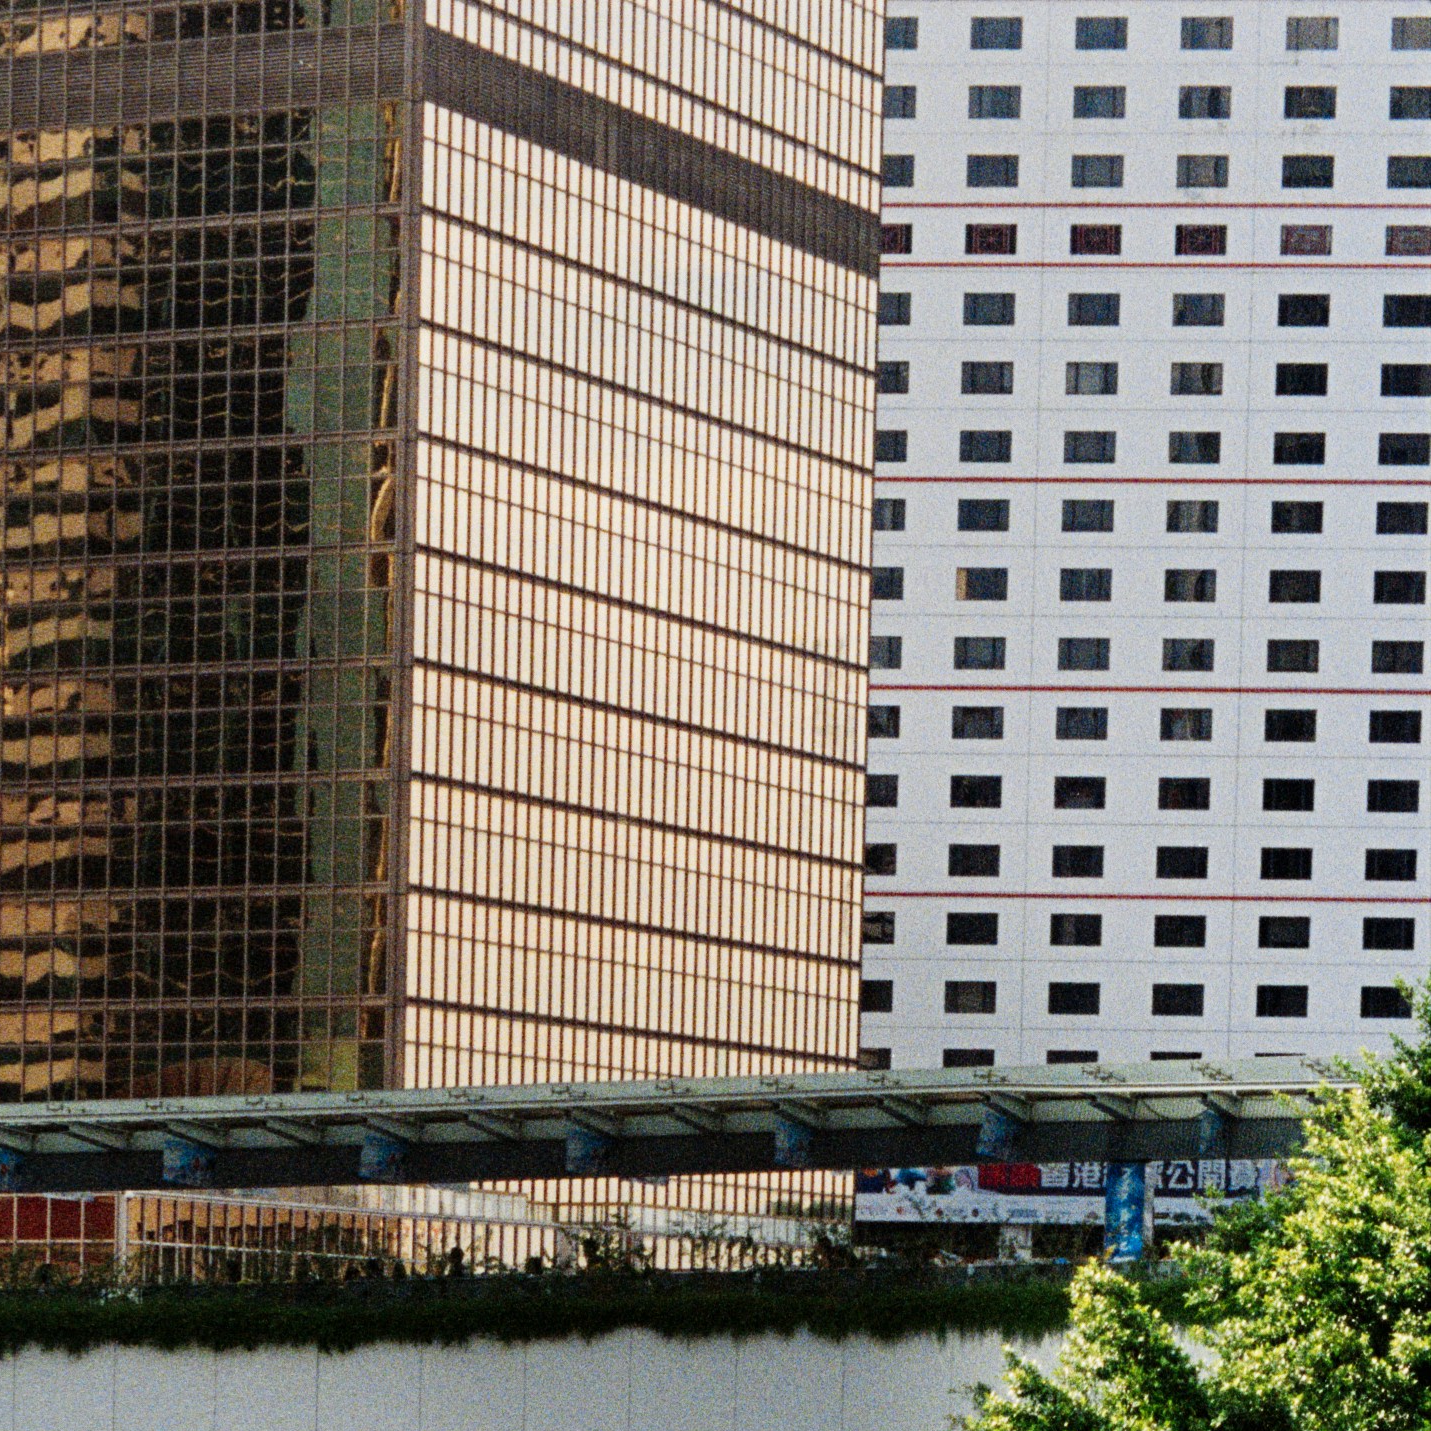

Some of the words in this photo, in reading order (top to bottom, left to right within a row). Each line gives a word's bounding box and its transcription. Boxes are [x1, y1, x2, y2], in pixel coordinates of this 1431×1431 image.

[1041, 1159, 1259, 1190] 香港公開賽
